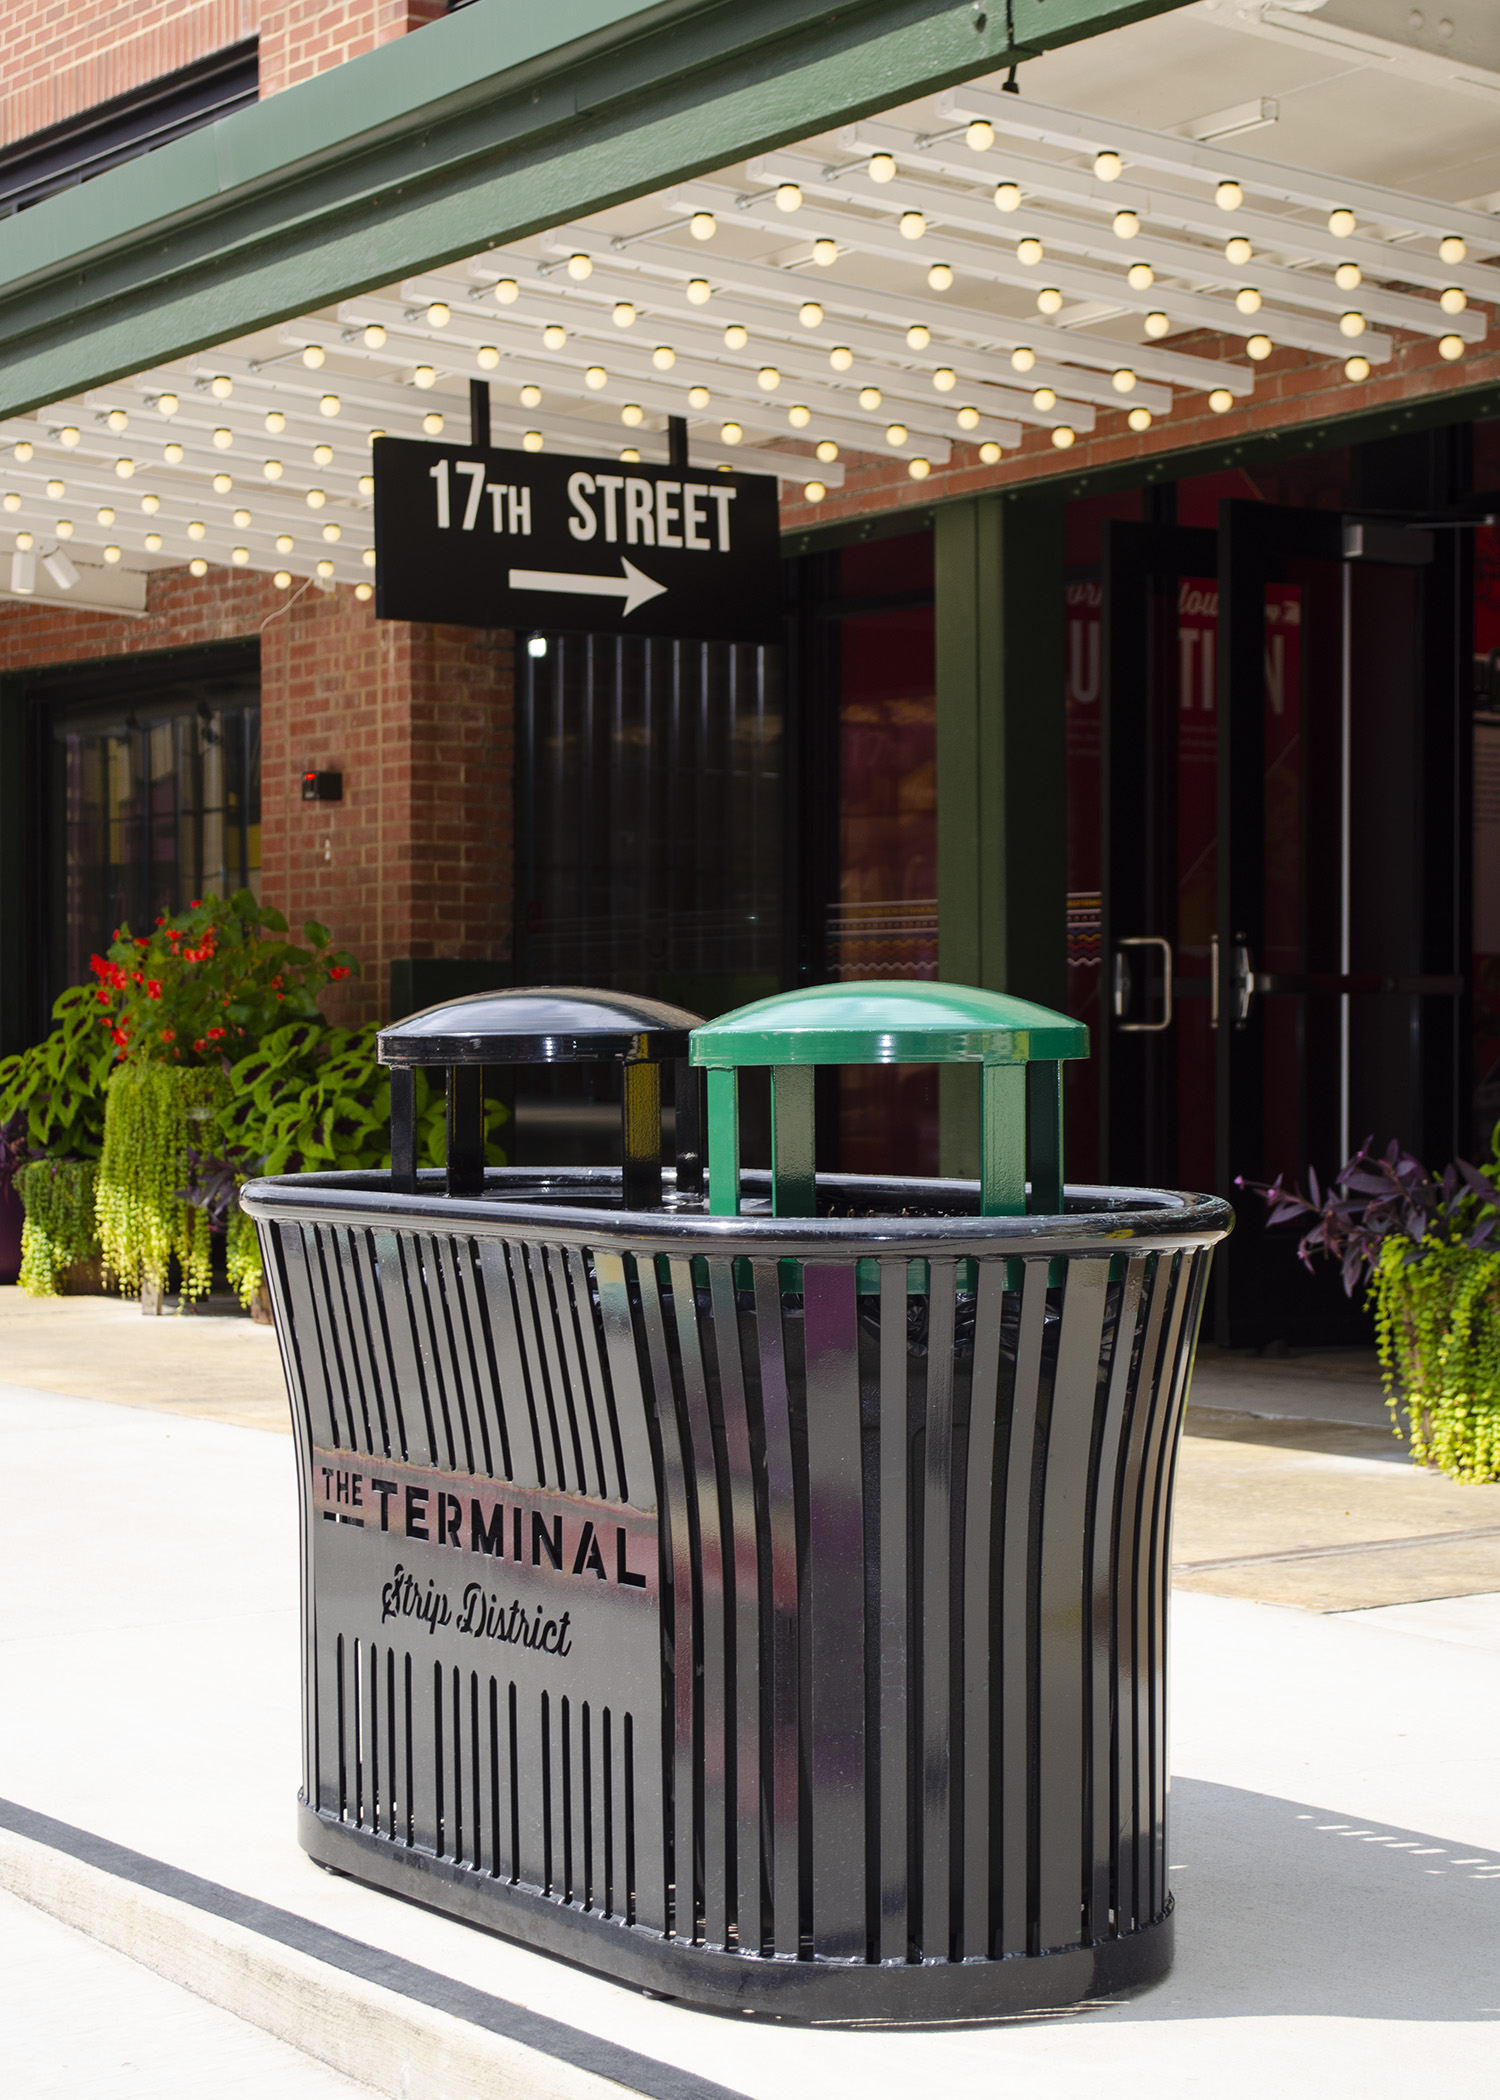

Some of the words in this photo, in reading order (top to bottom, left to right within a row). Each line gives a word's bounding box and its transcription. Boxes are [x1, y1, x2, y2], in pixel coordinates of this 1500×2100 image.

[429, 459, 532, 536] 17TH
[567, 471, 737, 552] STREET
[322, 1467, 363, 1507] THE
[371, 1478, 647, 1590] TERMINAL
[381, 1563, 451, 1635] Strip
[456, 1582, 572, 1658] District
